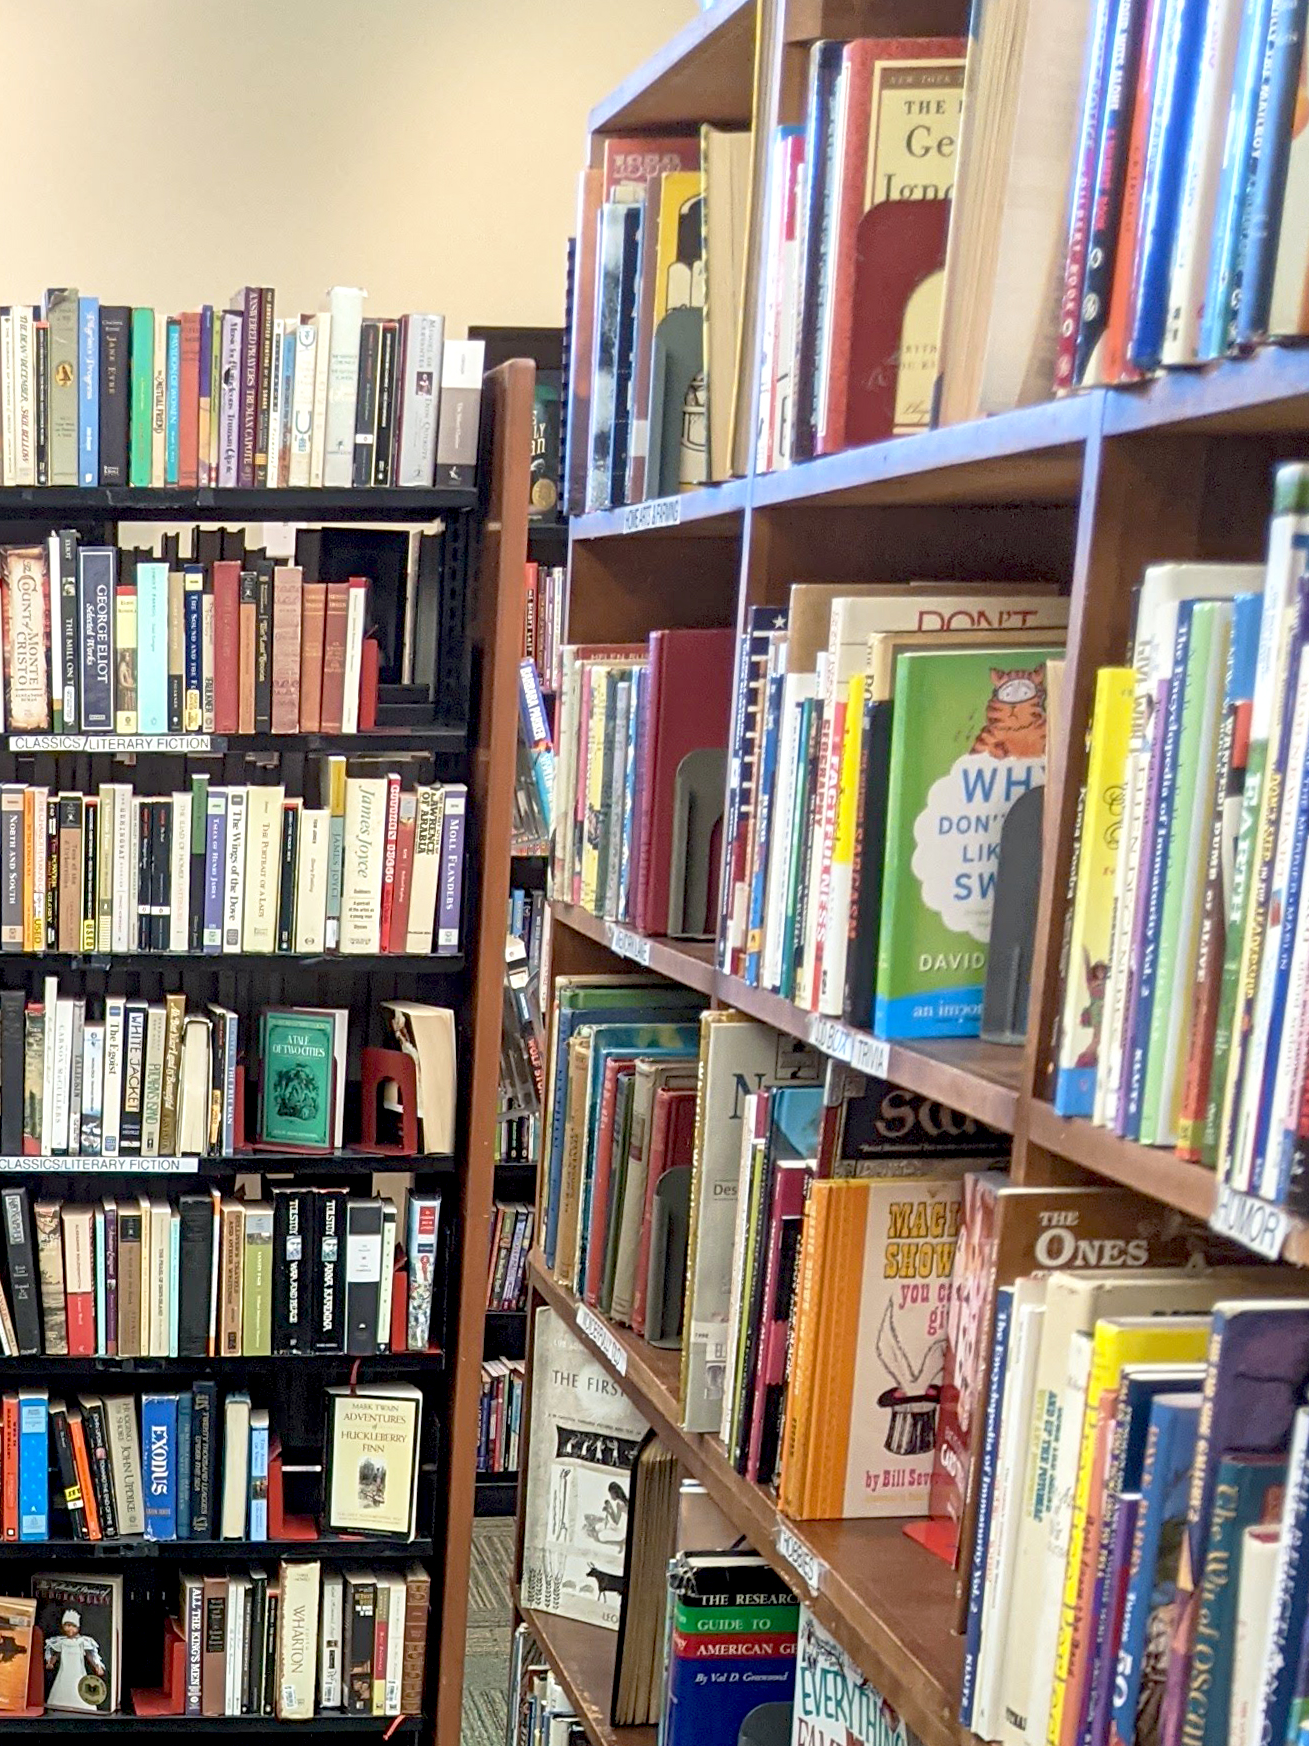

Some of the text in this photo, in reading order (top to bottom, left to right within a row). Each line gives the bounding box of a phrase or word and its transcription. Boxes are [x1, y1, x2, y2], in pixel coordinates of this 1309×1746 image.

[905, 100, 946, 115] THE
[243, 292, 258, 464] ANSWERED PRAYERS TRUMAN CAPOTE
[86, 603, 95, 635] Selected
[97, 585, 108, 683] GEORGE ELIOT
[917, 609, 1038, 632] DON'T
[16, 632, 28, 685] CRISTO
[28, 632, 38, 685] MONTE
[529, 709, 546, 740] PARKER
[15, 736, 209, 750] CLASSICS/LITERARY FICTION
[357, 786, 376, 834] James
[1074, 786, 1088, 827] Kama
[449, 820, 458, 851] MOLL
[816, 755, 839, 943] FACTFULNESS
[9, 815, 18, 904] NORTH SOUTH
[229, 810, 242, 920] The Wings the Dove
[331, 833, 341, 900] JAMES JOYCE
[355, 838, 373, 878] Joyce
[1145, 829, 1166, 937] Immaturity
[918, 953, 985, 973] DAVID
[912, 1003, 933, 1018] an
[107, 1023, 119, 1074] The Egoist
[127, 1016, 142, 1111] WHITE JACKET
[857, 1038, 885, 1072] TRIVIA
[130, 1158, 180, 1171] FICTION
[1039, 1211, 1080, 1228] THE
[1034, 1229, 1149, 1267] ONES
[900, 1285, 930, 1308] you
[552, 1370, 580, 1390] THE
[343, 1414, 406, 1423] ADVENTURES
[352, 1403, 399, 1412] MARK TWAIN
[341, 1431, 407, 1443] HUCKLEBERRY
[363, 1444, 385, 1453] FINN
[151, 1426, 169, 1495] EXODUS
[121, 1446, 135, 1512] JOHN UPDIKE
[865, 1470, 906, 1491] by Bill
[973, 1474, 993, 1569] Immaturity
[780, 1529, 815, 1581] HOBBIES
[701, 1594, 731, 1606] THE
[190, 1588, 201, 1685] ALL THE KING'S MEN
[290, 1607, 304, 1674] WHARTON
[697, 1619, 771, 1631] GUIDE TO
[697, 1643, 774, 1656] AMERICAN
[694, 1671, 789, 1685] By Val Greenwood
